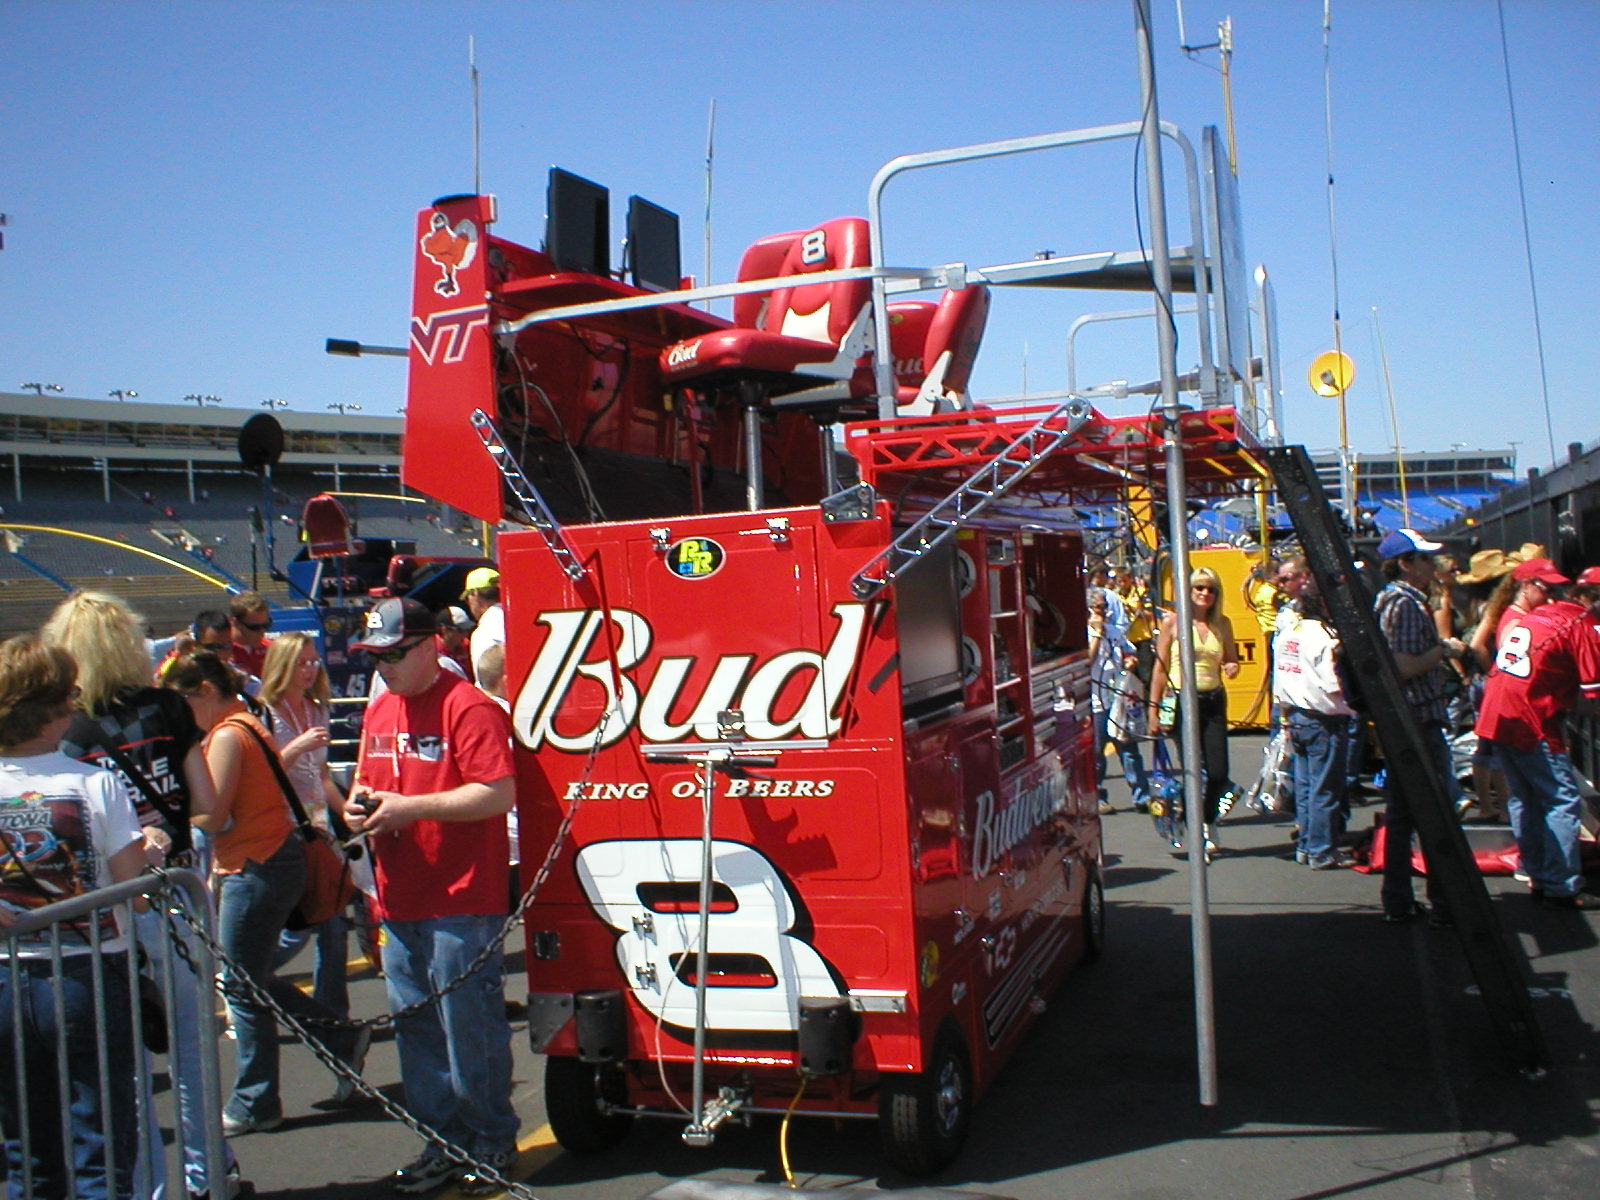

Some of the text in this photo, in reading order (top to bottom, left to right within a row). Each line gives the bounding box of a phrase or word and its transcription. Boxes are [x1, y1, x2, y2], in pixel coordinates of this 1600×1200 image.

[802, 229, 827, 265] 8
[411, 304, 490, 365] VT
[668, 339, 703, 367] Bud
[367, 612, 383, 629] 8
[1495, 625, 1532, 679] 8
[513, 601, 869, 753] Bud
[562, 782, 649, 800] KING
[724, 779, 835, 798] BEERS
[573, 838, 852, 1052] 8
